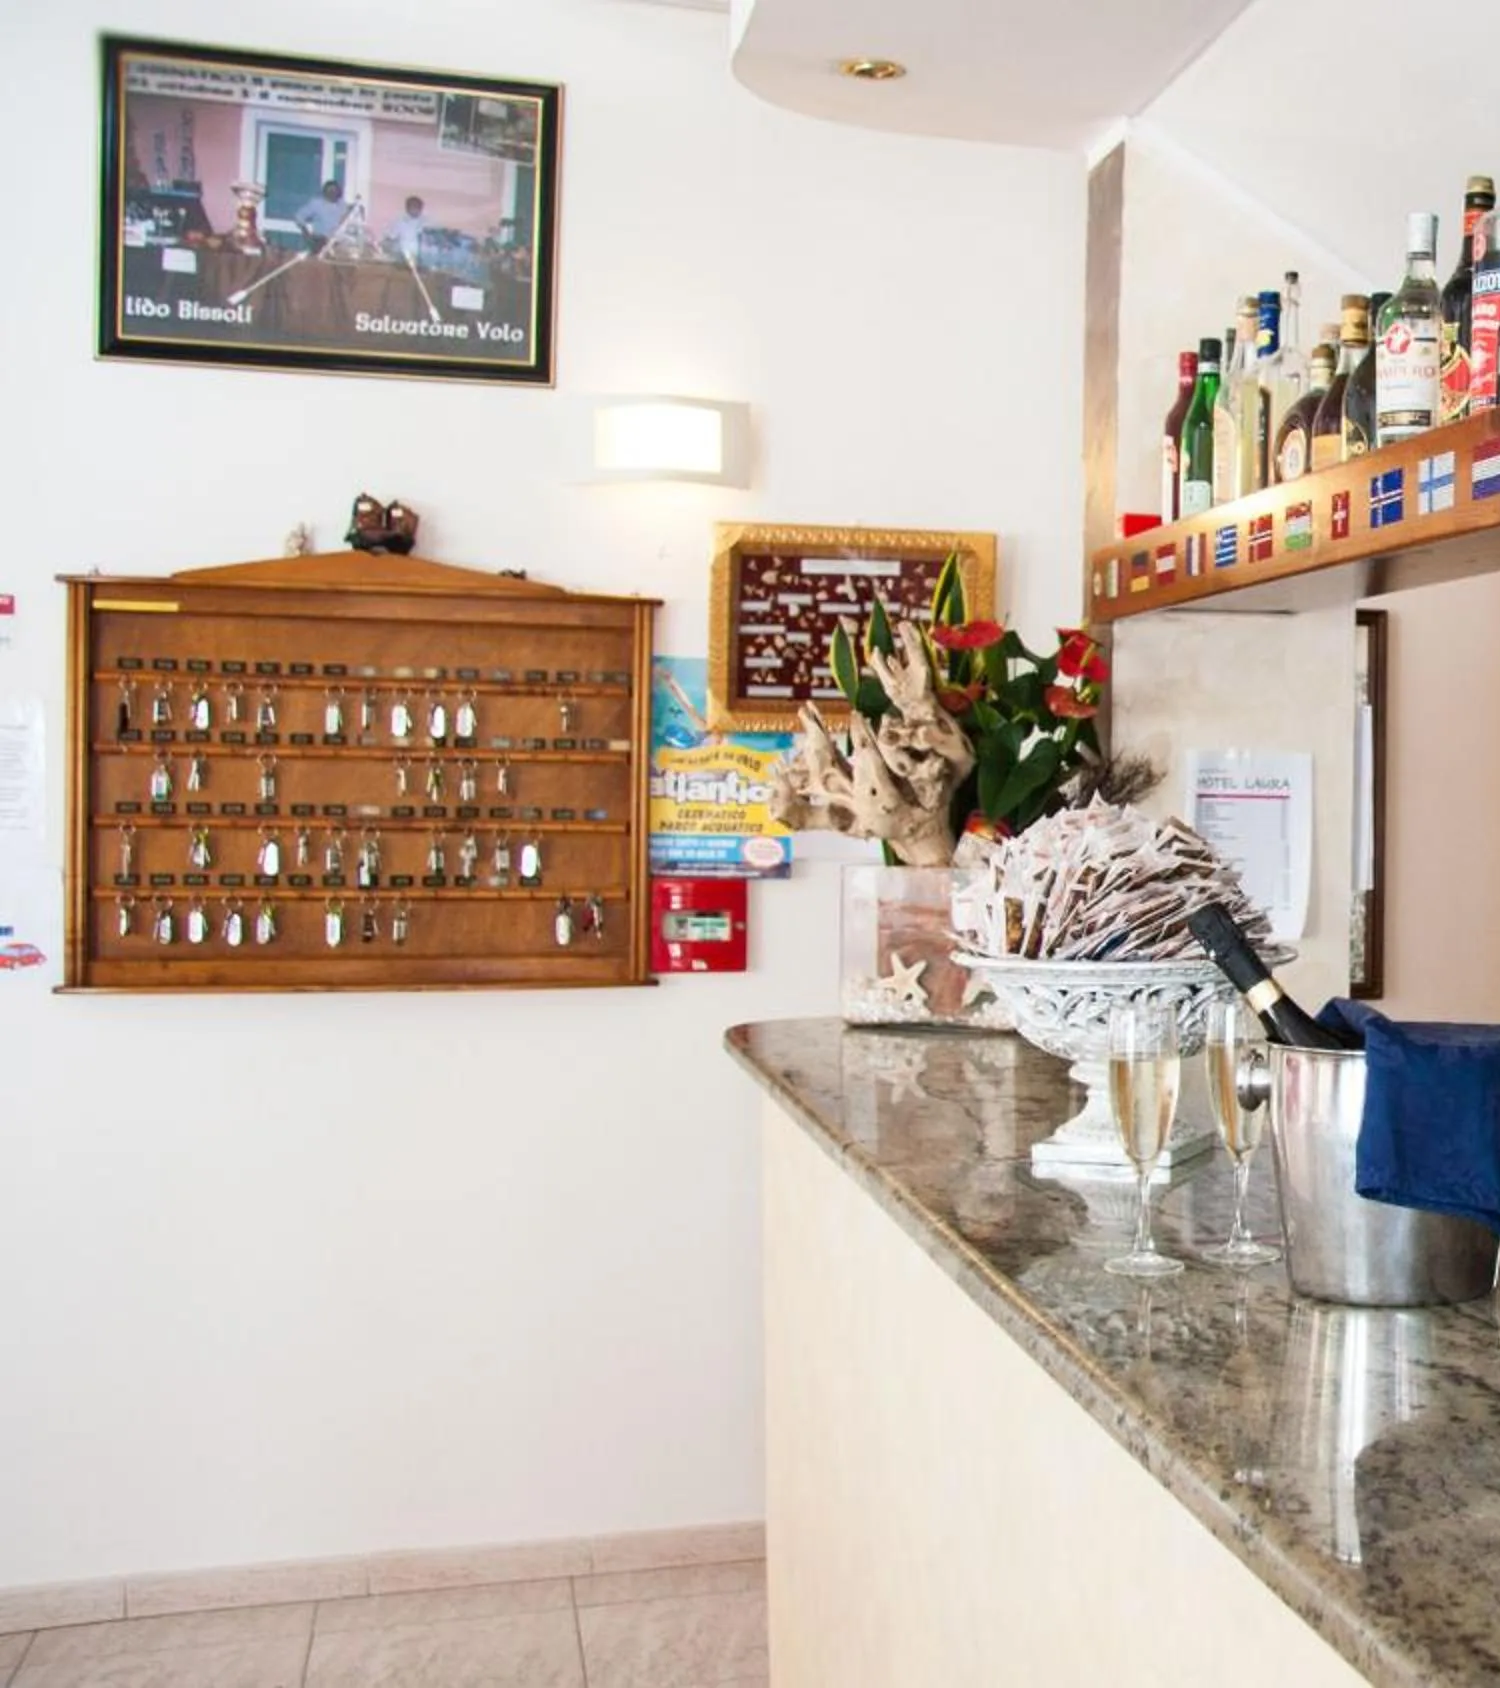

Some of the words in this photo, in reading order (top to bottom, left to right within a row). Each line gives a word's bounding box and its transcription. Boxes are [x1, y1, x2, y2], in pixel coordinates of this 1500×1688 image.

[354, 312, 470, 338] Salvatore
[476, 321, 525, 342] Volo
[1196, 776, 1238, 790] HOTEL
[1244, 776, 1291, 791] LAURA
